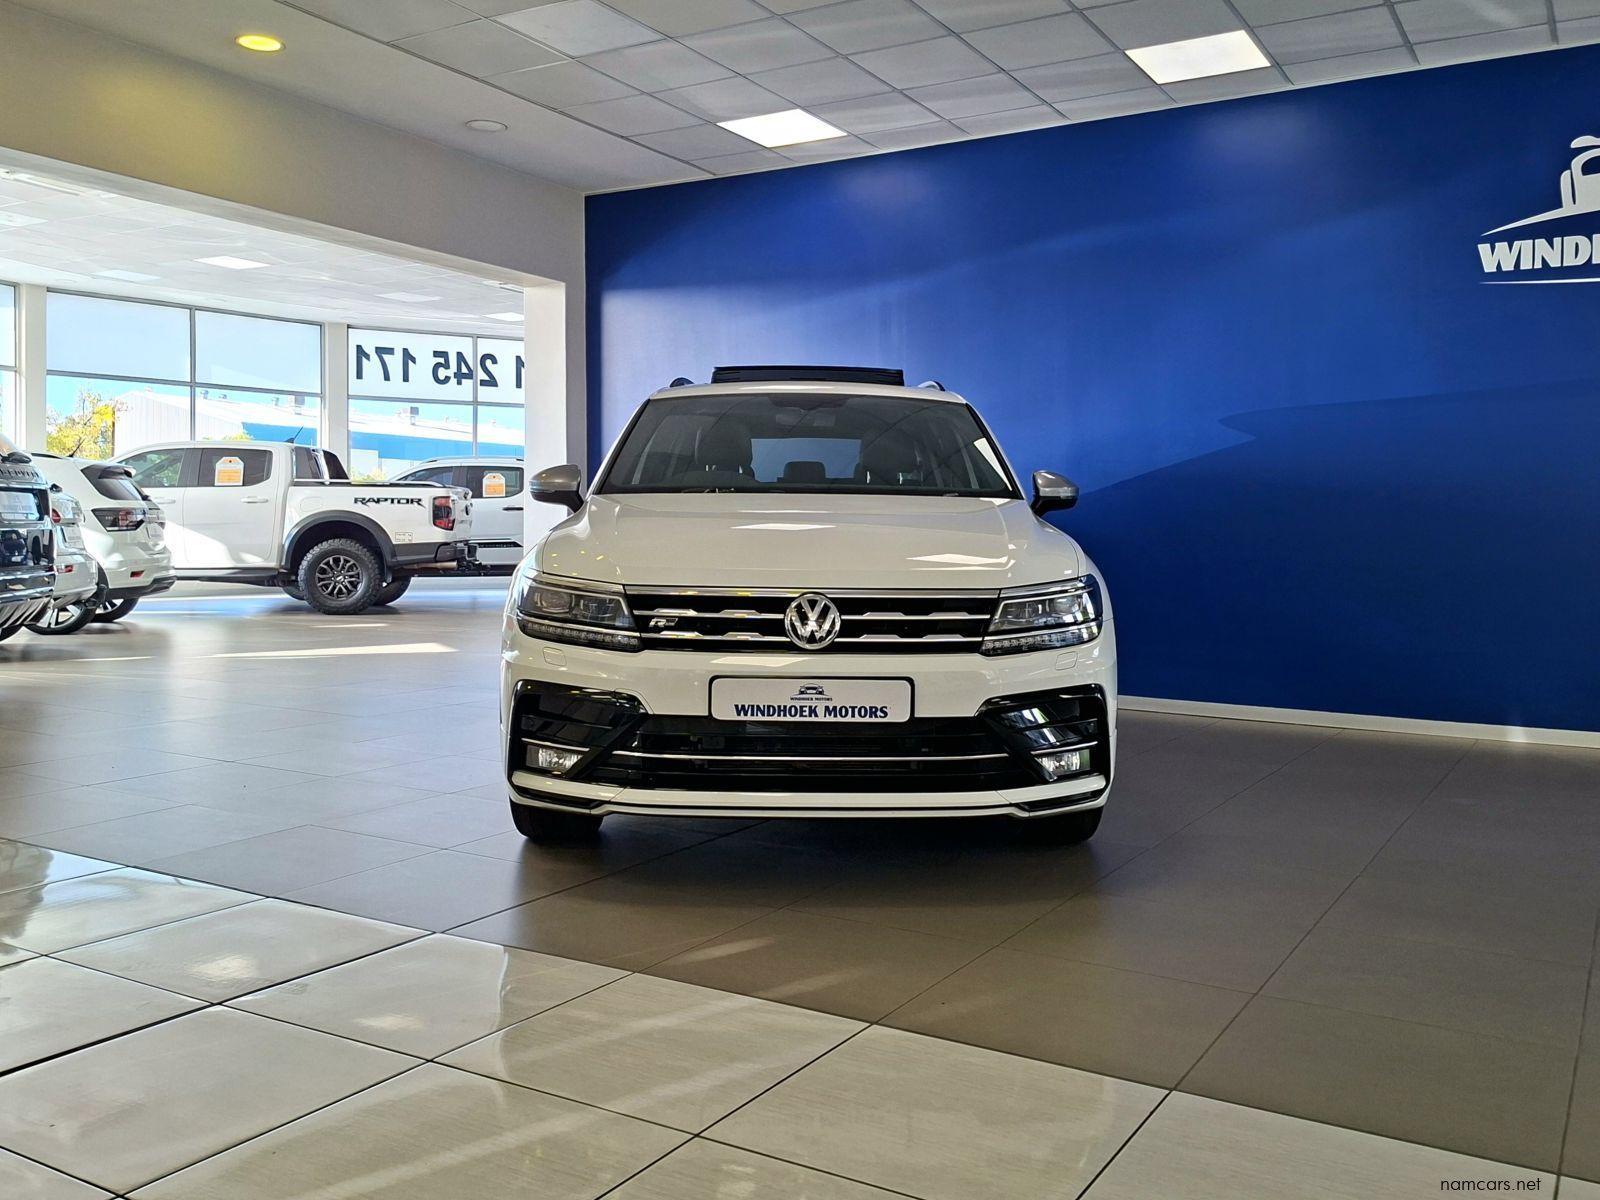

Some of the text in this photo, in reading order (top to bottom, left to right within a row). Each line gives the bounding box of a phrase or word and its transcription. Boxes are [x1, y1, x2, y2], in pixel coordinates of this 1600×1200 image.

[353, 497, 426, 509] RAPTOR
[734, 703, 889, 719] WINDHOEK MOTORS
